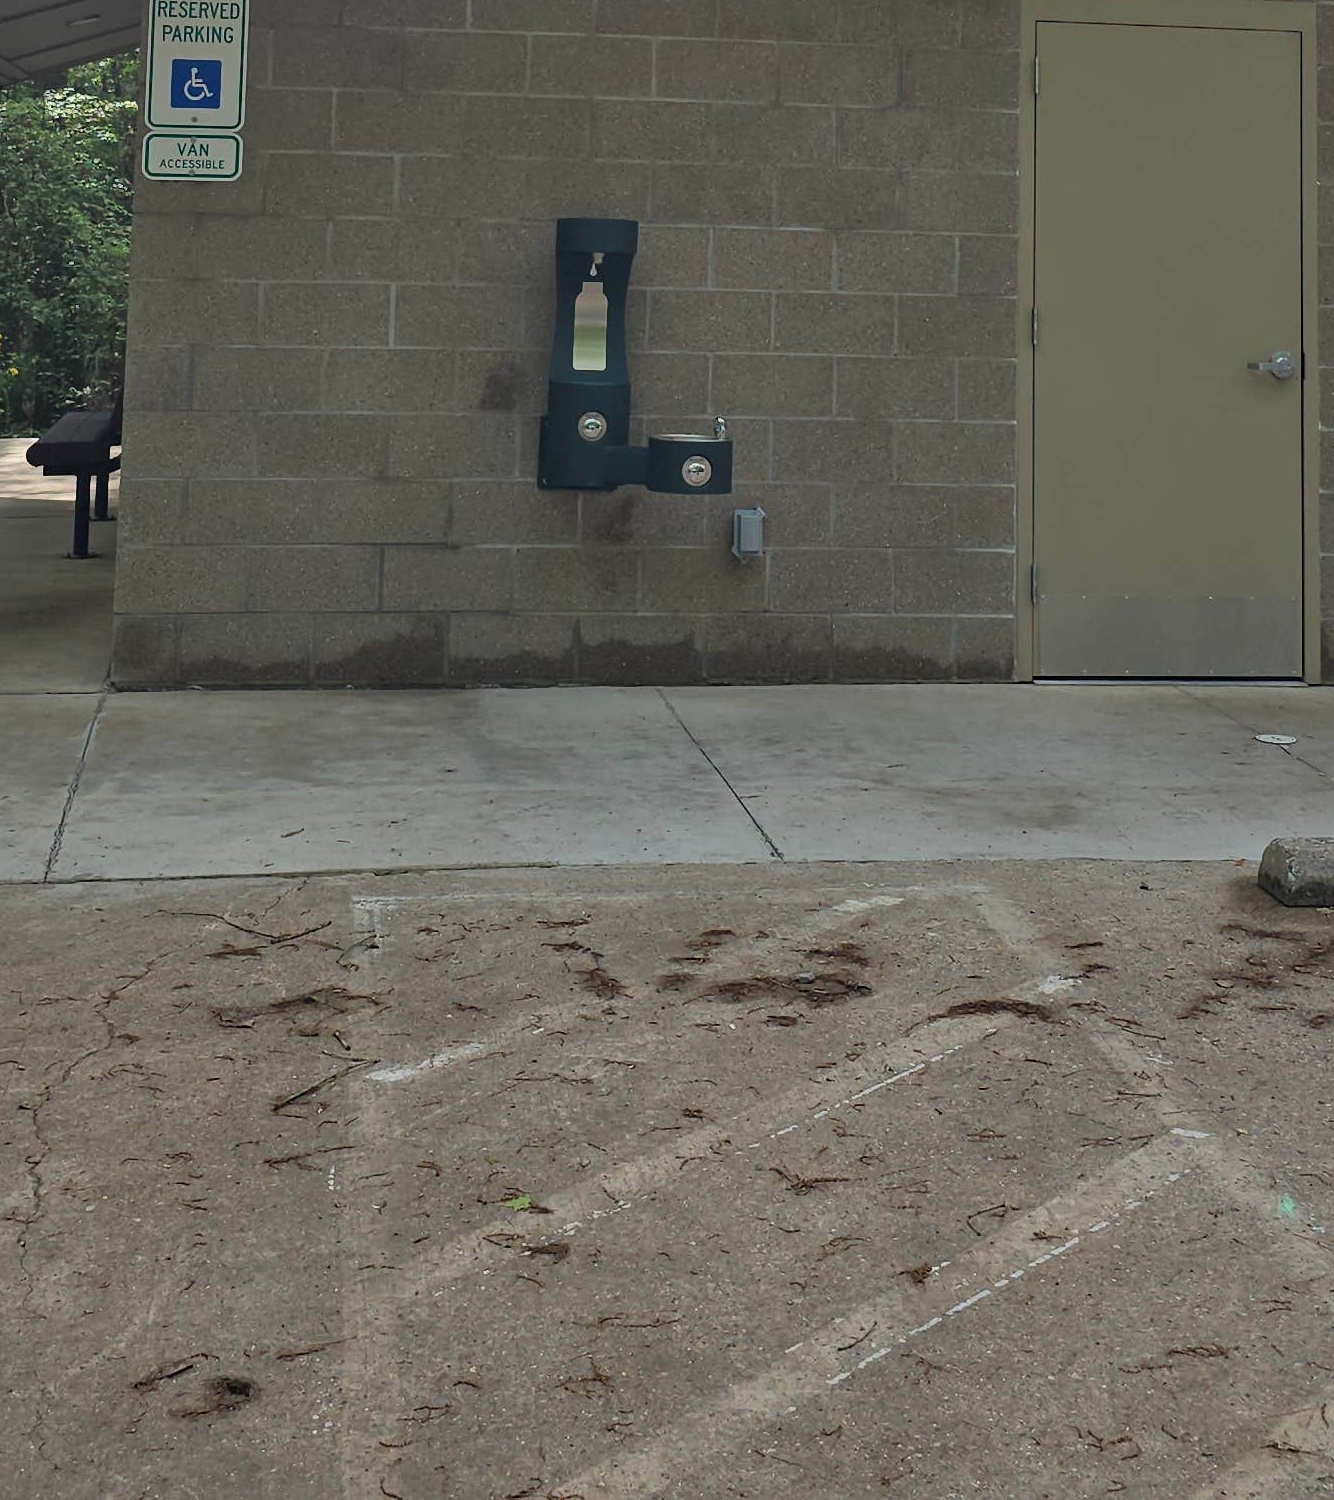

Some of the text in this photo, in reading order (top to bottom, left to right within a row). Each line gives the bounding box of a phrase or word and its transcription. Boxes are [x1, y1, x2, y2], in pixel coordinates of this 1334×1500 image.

[157, 0, 240, 19] RESERVED
[162, 24, 234, 44] PARKING
[177, 142, 209, 157] VAN
[159, 159, 225, 169] ACCESSIBLE
